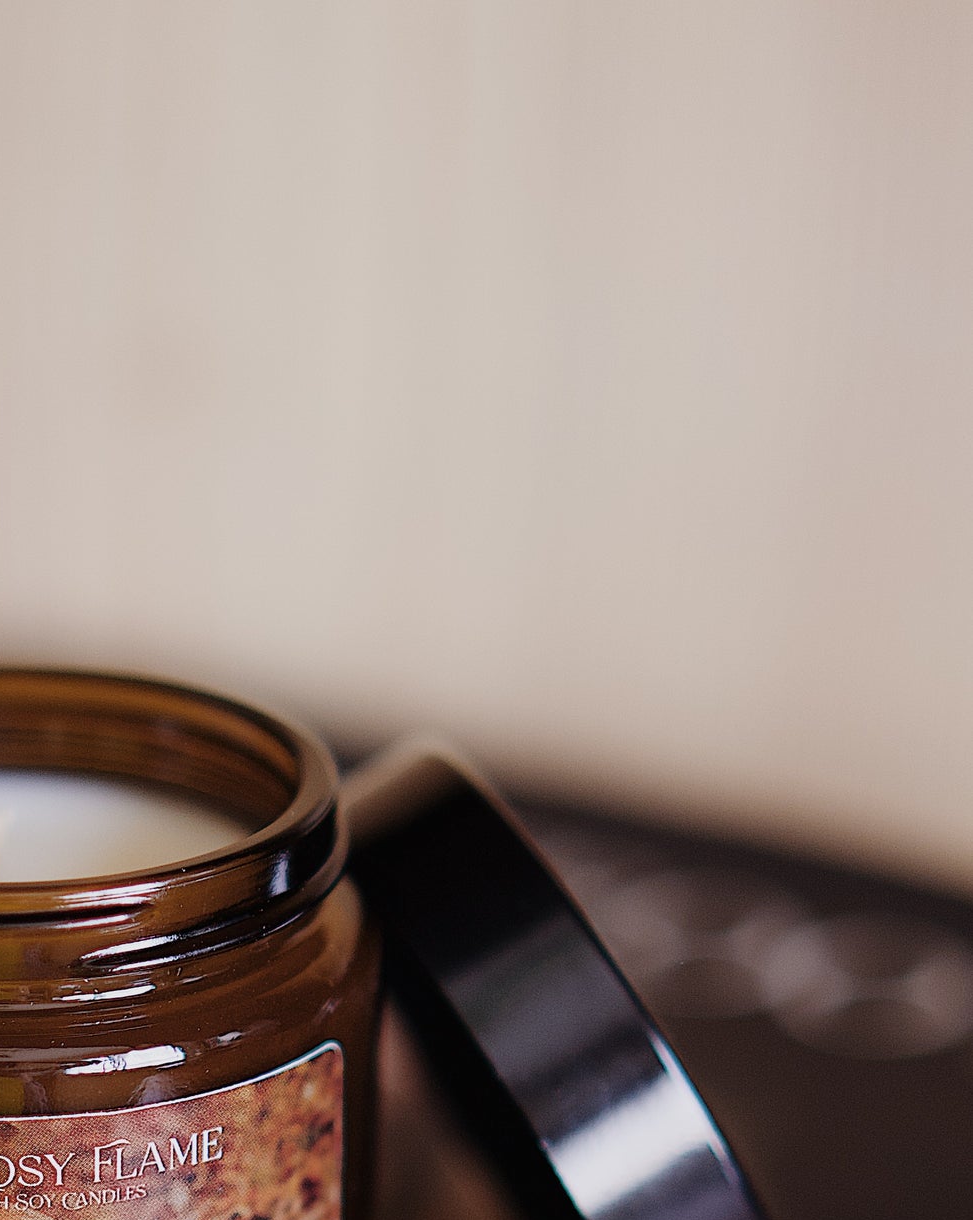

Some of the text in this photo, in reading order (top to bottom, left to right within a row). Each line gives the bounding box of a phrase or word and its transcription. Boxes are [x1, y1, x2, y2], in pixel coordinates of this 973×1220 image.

[93, 1126, 224, 1184] FLAME
[14, 1192, 55, 1212] SOY
[61, 1183, 147, 1211] CANDLES
